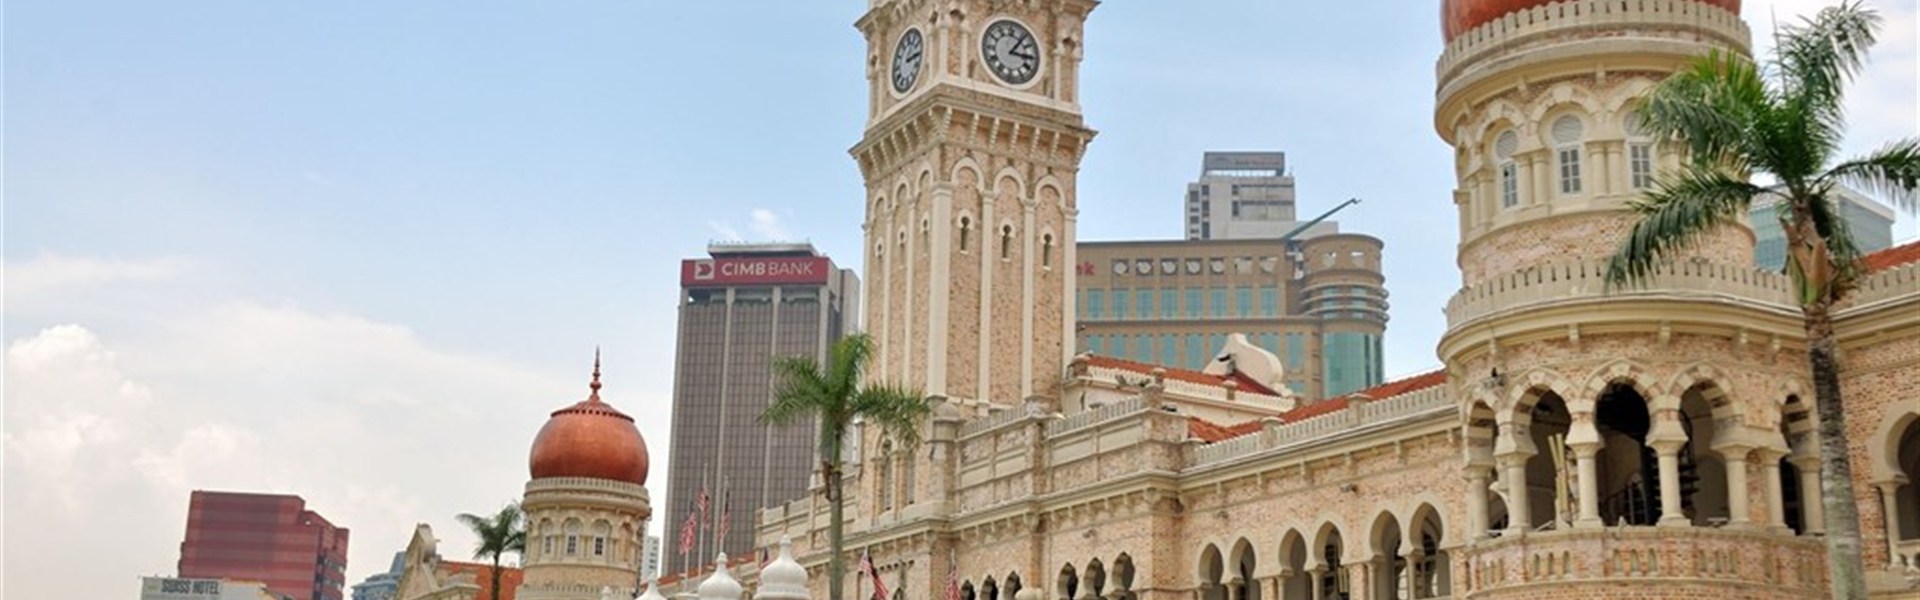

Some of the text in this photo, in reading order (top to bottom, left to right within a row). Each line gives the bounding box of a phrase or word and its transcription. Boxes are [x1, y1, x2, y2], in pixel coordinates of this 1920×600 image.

[721, 261, 813, 276] CIMB BANK
[192, 580, 220, 595] HOTEL
